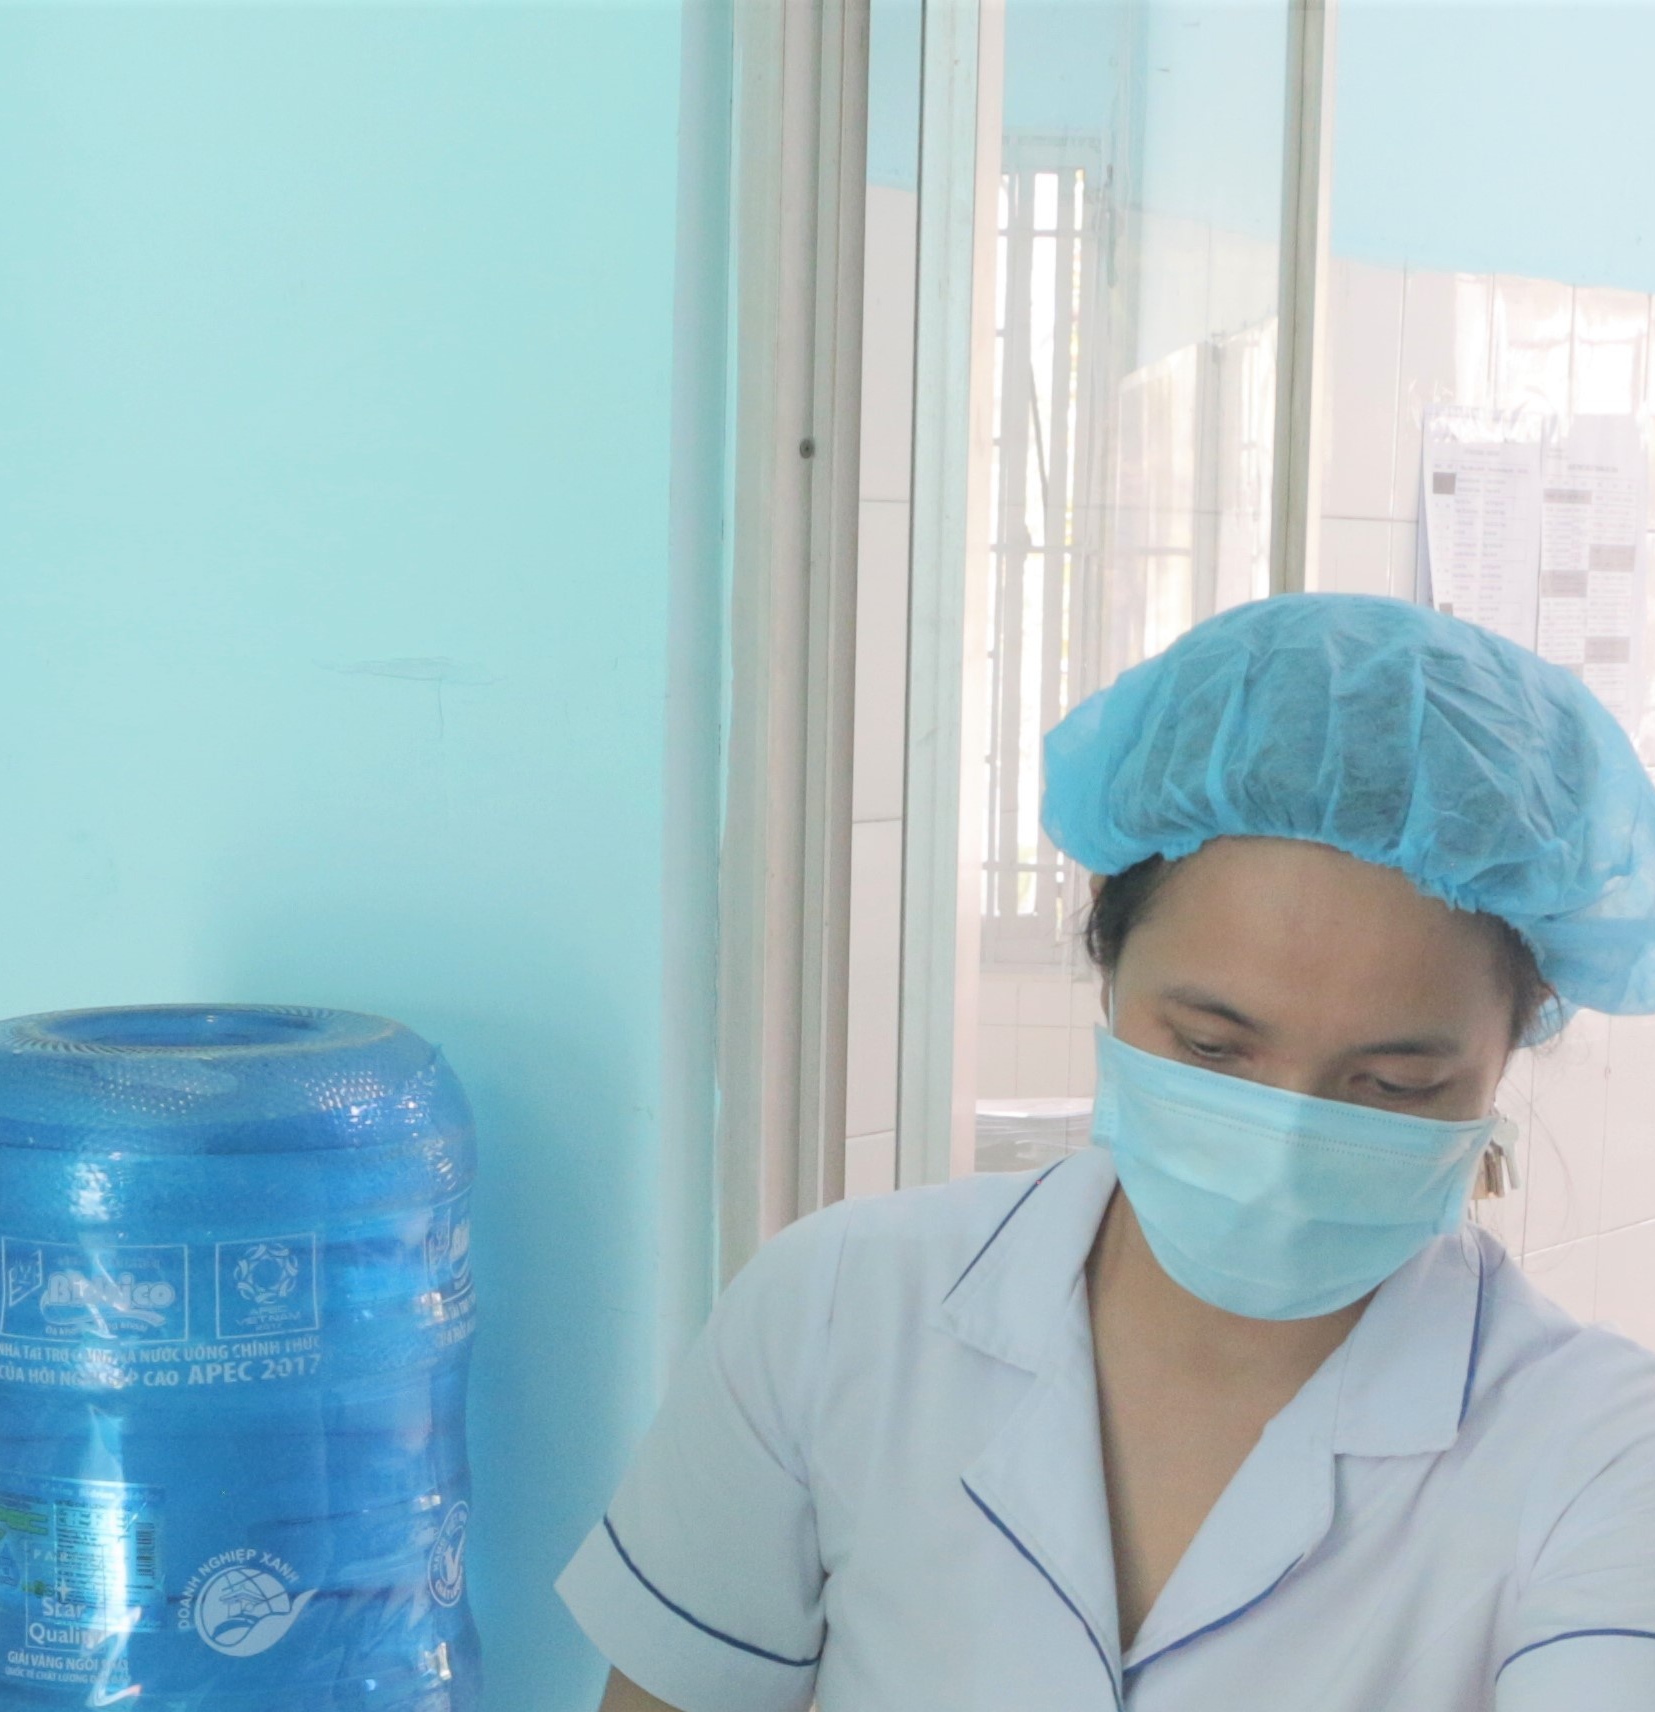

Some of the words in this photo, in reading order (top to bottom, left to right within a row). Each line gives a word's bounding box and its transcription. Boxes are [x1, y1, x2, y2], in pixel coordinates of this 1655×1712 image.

[231, 1338, 281, 1359] CHÍNH
[143, 1370, 179, 1387] CAO
[187, 1360, 254, 1386] APEC
[260, 1353, 322, 1381] 2017
[177, 1575, 202, 1630] DOANH
[197, 1547, 258, 1577] NGHIỆP
[259, 1551, 301, 1585] XANH
[42, 1595, 87, 1618] Star
[28, 1622, 101, 1649] Quali
